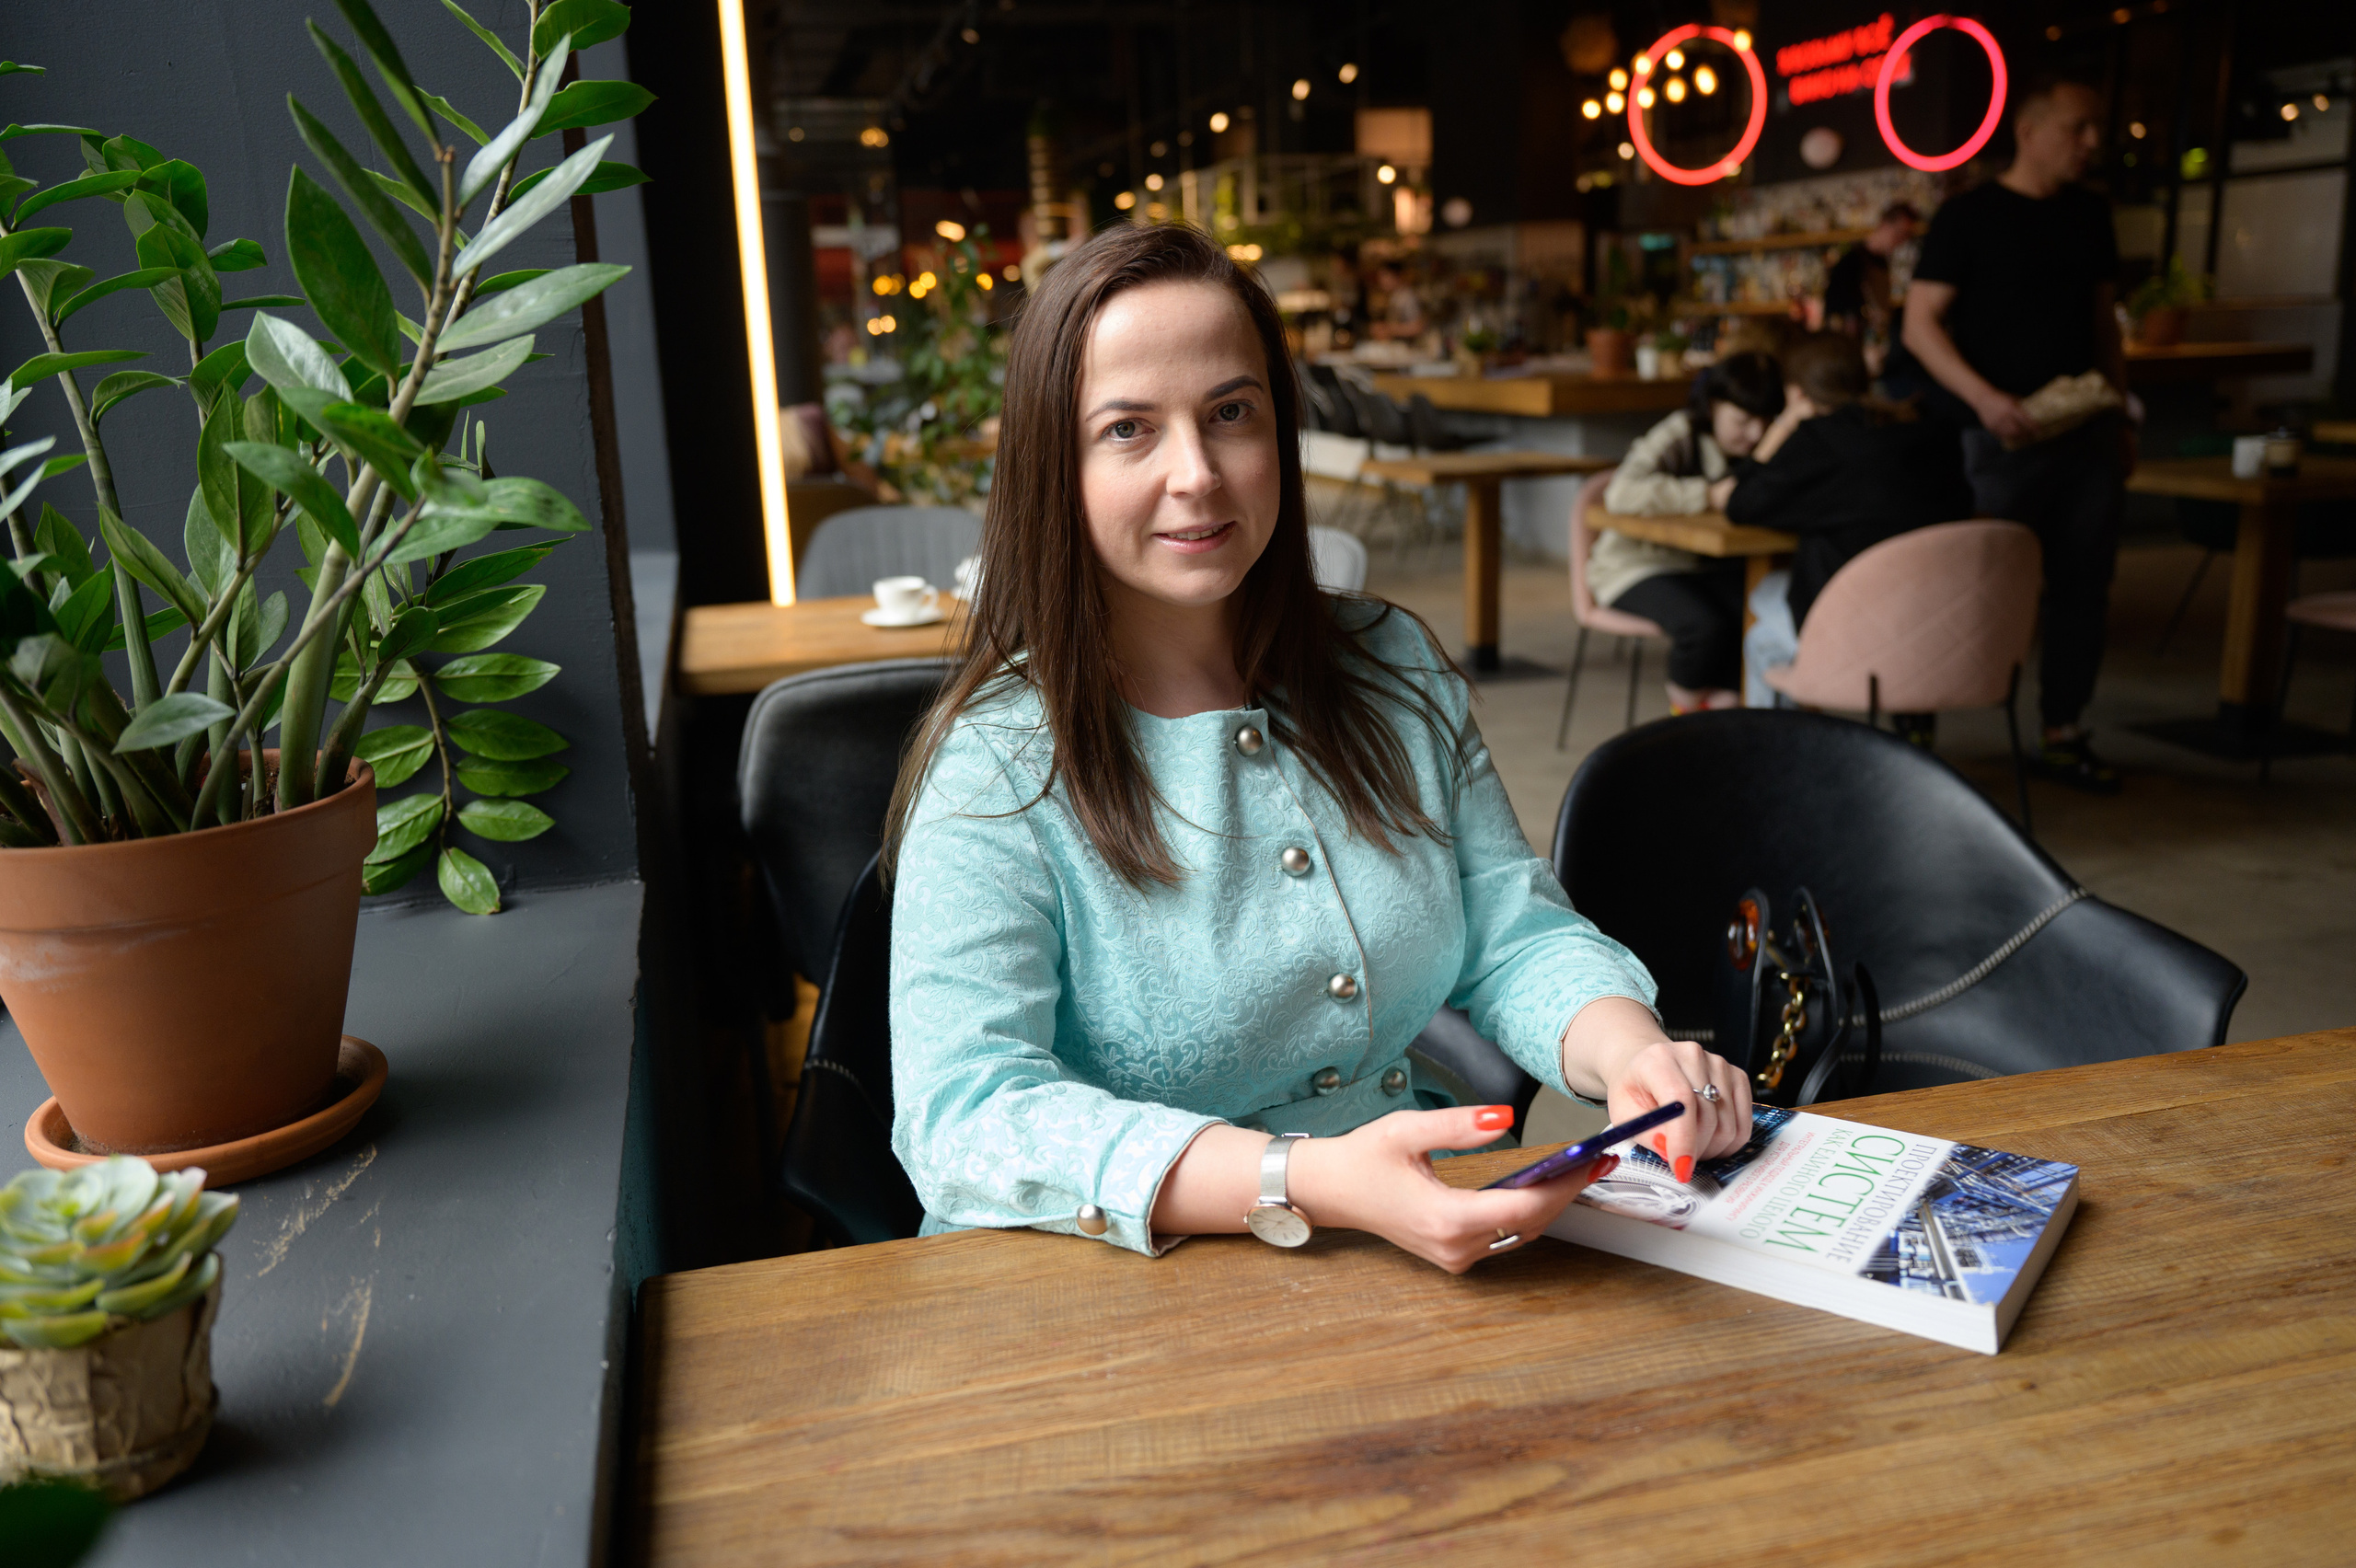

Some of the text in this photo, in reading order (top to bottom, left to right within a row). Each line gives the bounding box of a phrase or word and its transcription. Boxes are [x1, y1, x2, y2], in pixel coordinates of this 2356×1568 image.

[1738, 1127, 1854, 1240] КАК ЕДИНОГО ЦЕЛОГО
[1763, 1135, 1906, 1252] СИСТЕМ
[1825, 1144, 1937, 1264] ПРОЕКТИРОВАНИЕ
